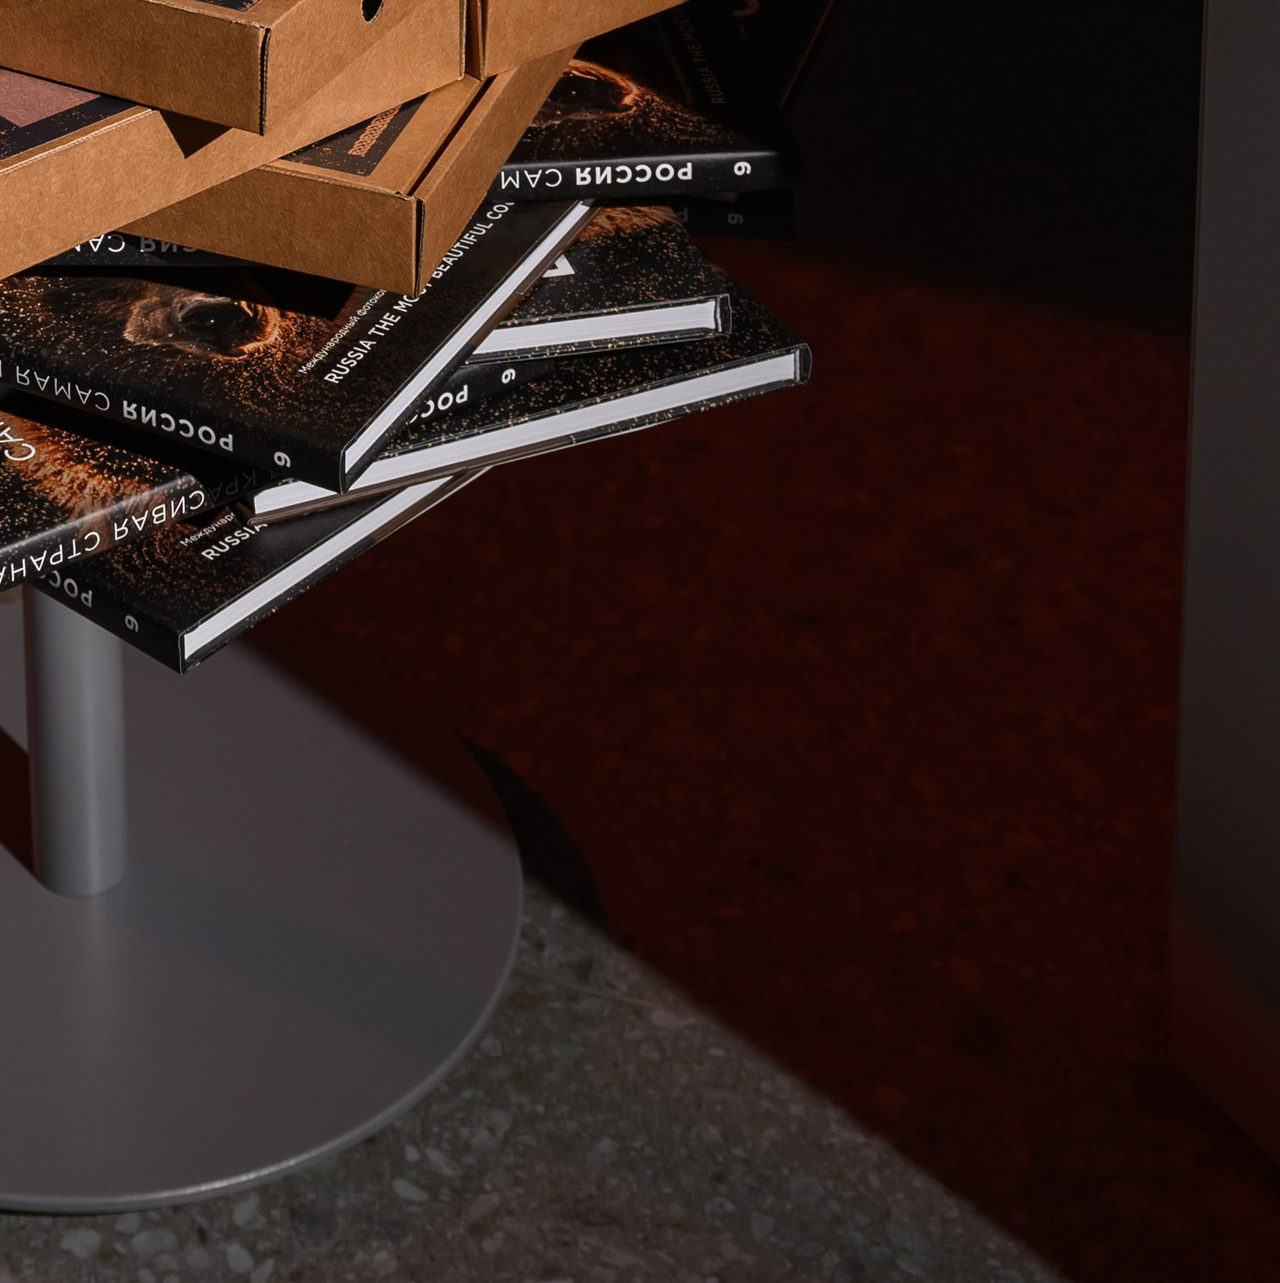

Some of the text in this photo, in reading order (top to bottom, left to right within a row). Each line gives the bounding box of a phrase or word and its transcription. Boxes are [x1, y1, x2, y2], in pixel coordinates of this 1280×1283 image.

[501, 167, 562, 190] САМ
[575, 161, 693, 185] РОССИЯ
[324, 221, 495, 384] RUSSIA THE BEAUTIFUL
[298, 288, 388, 376] Международный фотоко
[15, 368, 112, 412] САМАЯ
[410, 384, 469, 424] РОС
[122, 399, 235, 453] РОССИЯ
[180, 511, 236, 547] Междунар
